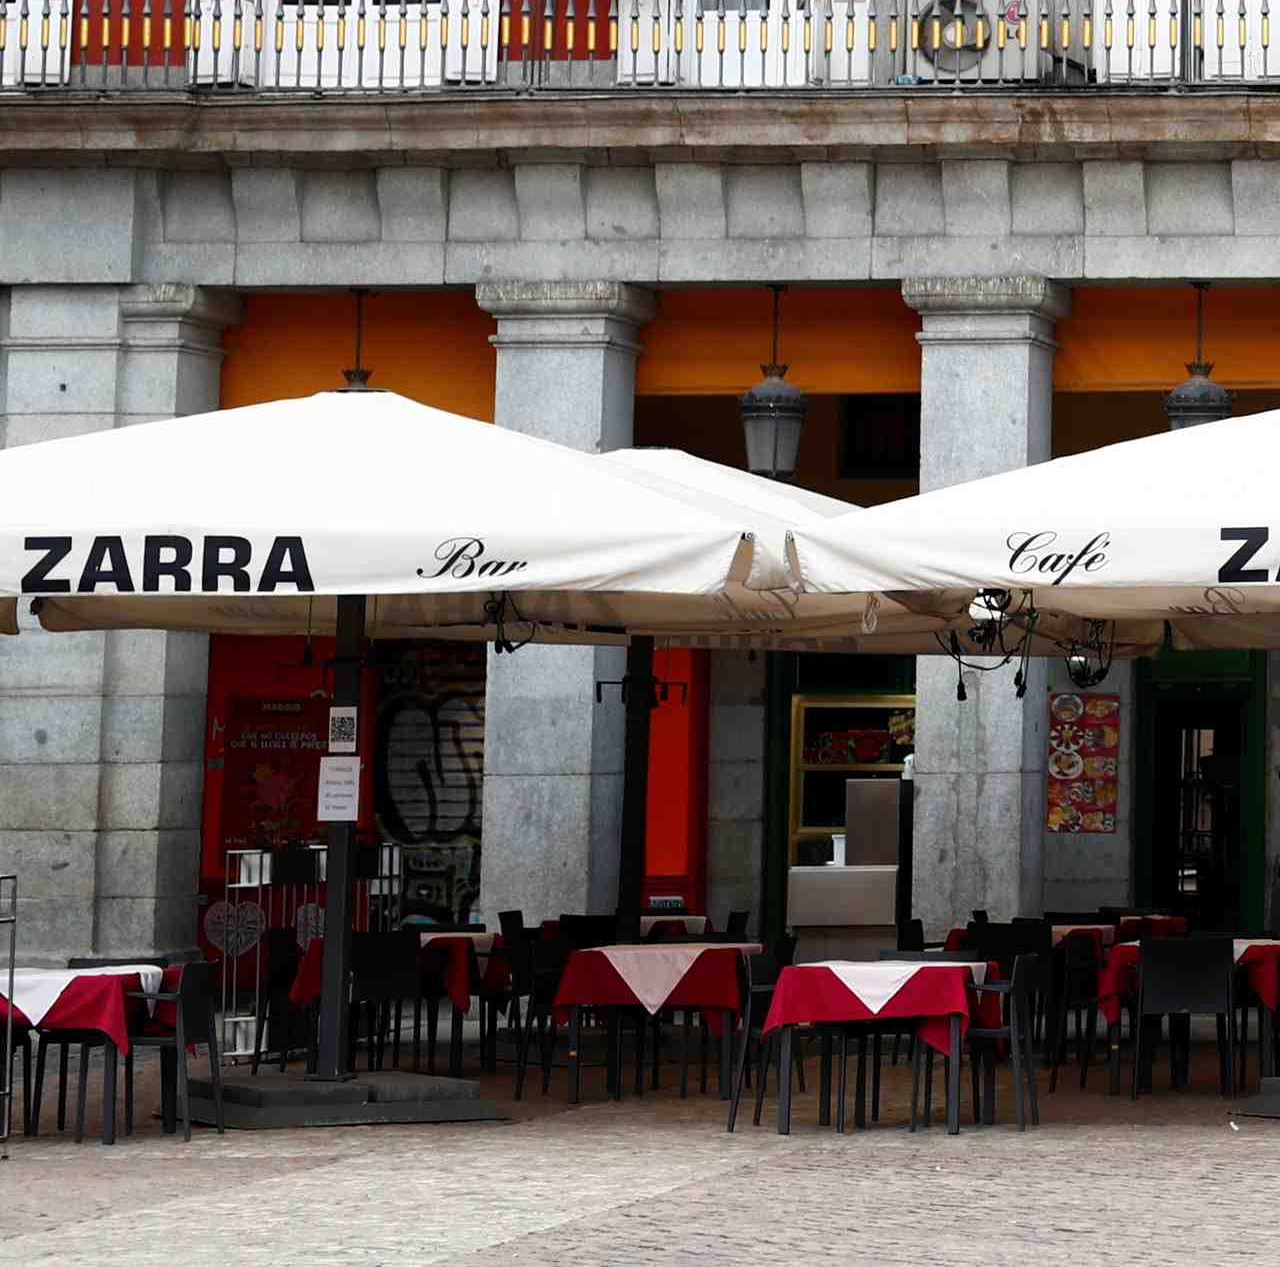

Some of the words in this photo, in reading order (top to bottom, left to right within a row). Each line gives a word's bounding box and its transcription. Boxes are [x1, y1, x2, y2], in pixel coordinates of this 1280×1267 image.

[20, 535, 316, 594] ZARRA
[416, 536, 528, 579] Bar
[1004, 530, 1111, 586] Café
